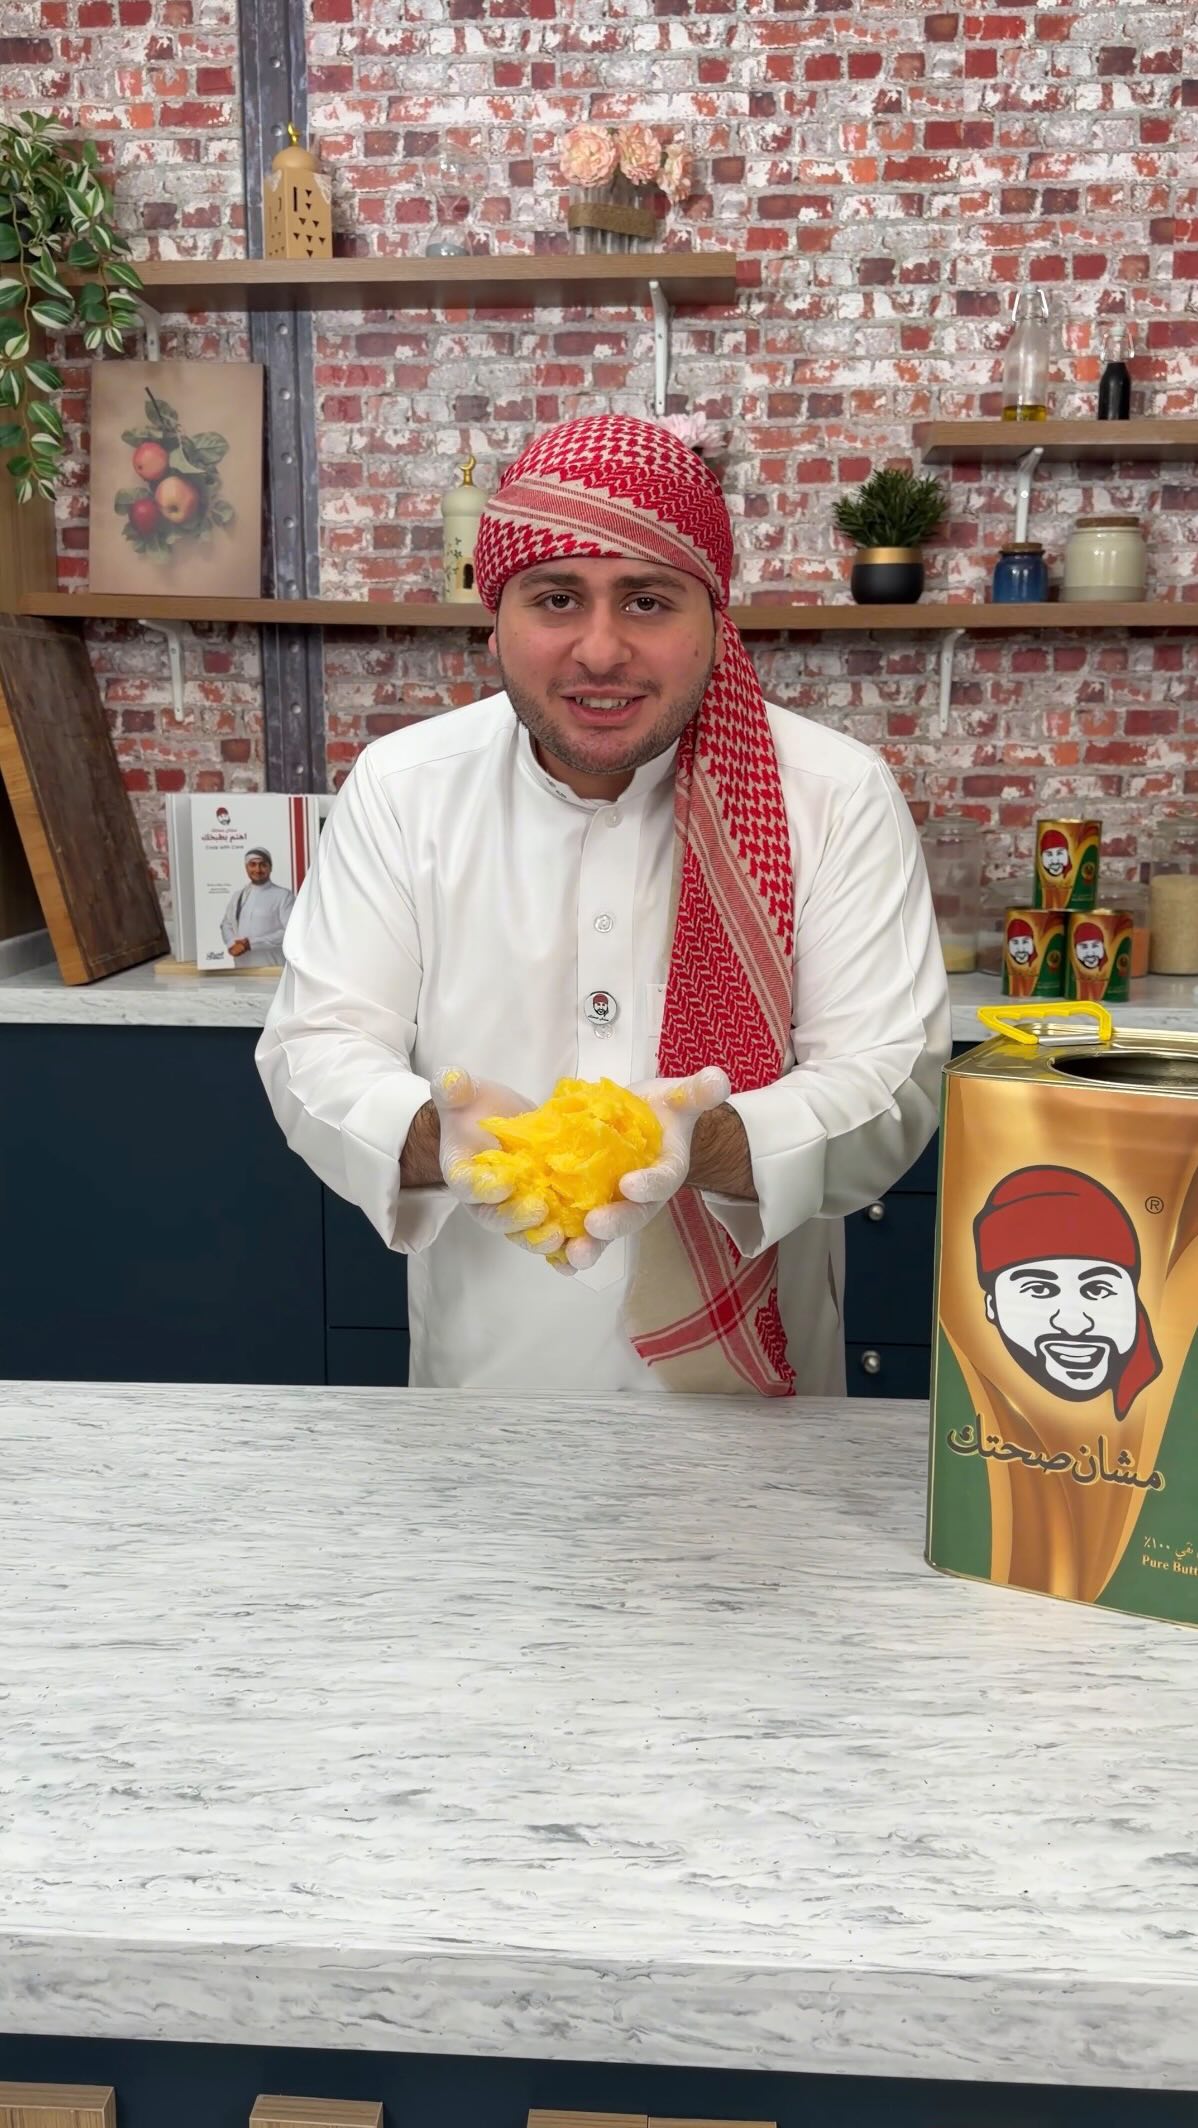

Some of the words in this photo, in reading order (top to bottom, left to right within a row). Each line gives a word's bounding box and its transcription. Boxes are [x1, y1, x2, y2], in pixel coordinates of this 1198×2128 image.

[946, 1413, 1075, 1474] صحتك
[1072, 1434, 1166, 1491] مشان
[1142, 1554, 1169, 1570] Pure
[1173, 1561, 1198, 1576] Butt
